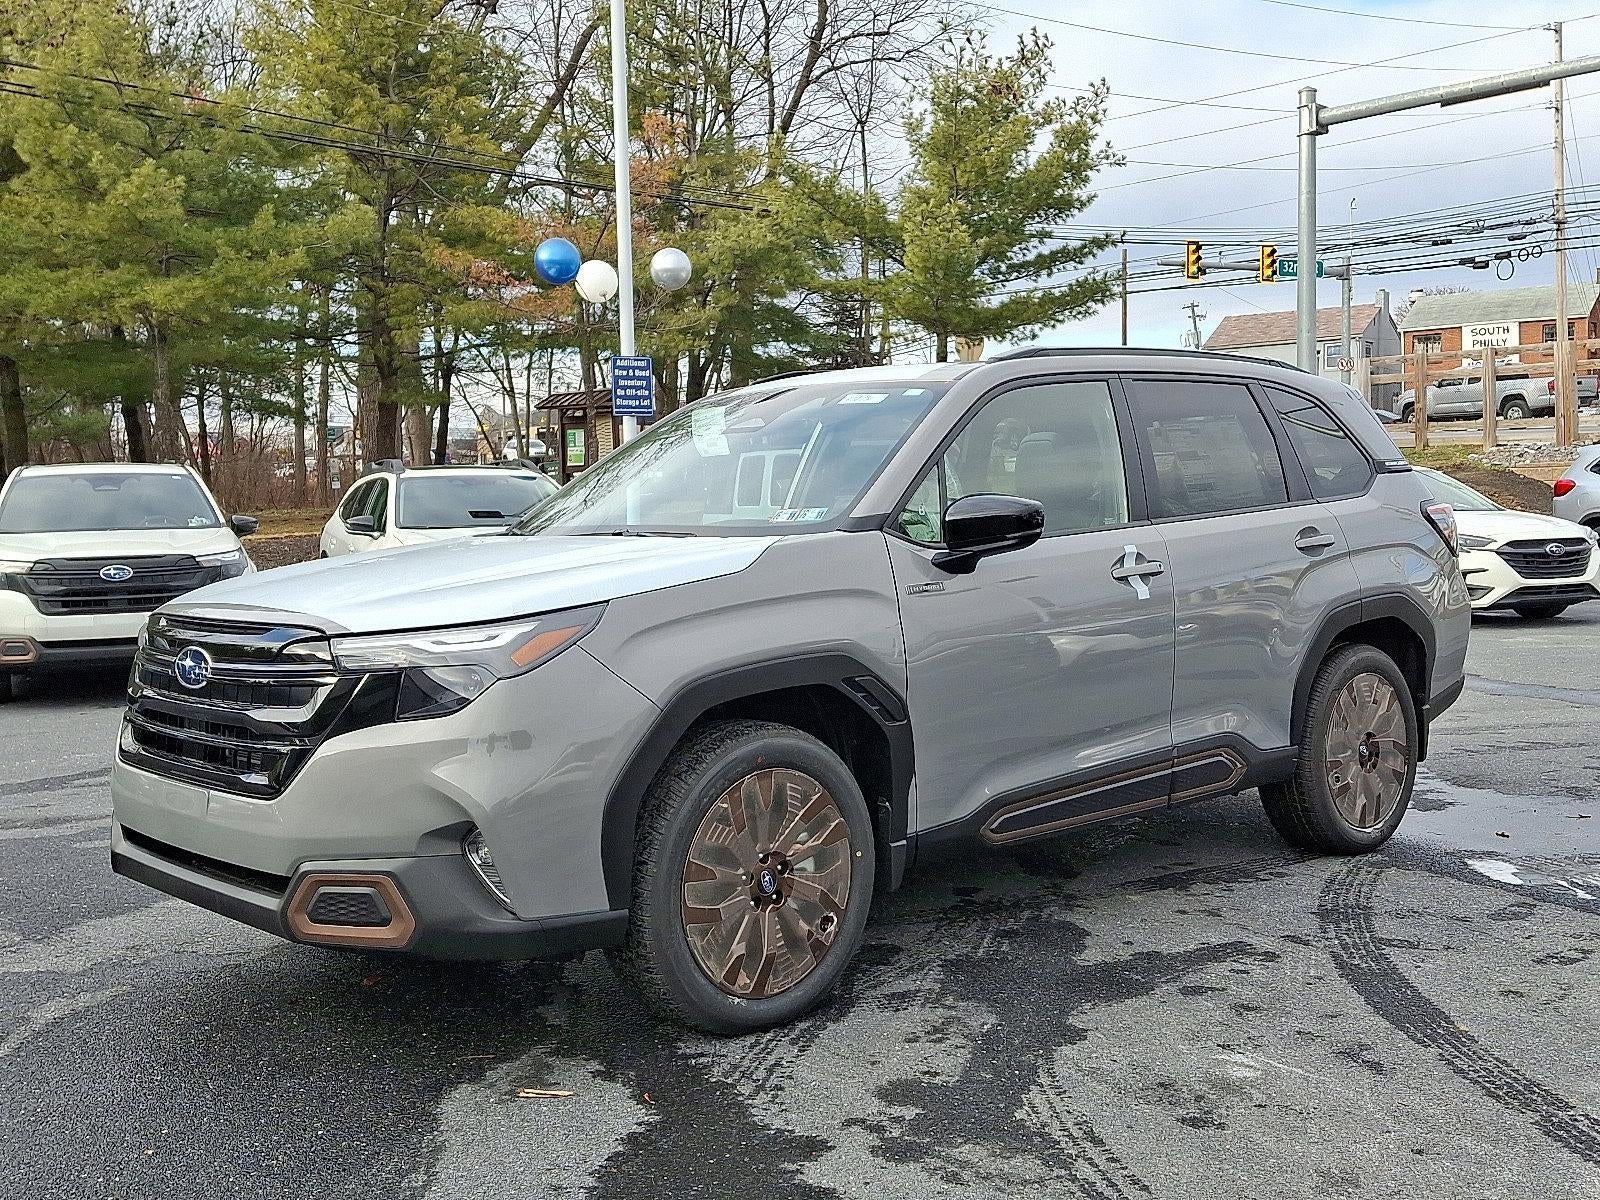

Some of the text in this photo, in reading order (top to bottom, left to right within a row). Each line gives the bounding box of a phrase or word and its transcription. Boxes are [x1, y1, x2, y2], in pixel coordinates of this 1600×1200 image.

[1283, 261, 1298, 273] 32n
[1471, 326, 1510, 337] SOUTH
[1472, 338, 1508, 348] PHILLY
[616, 359, 647, 367] Additional
[618, 379, 647, 388] Inventory
[616, 388, 624, 396] On
[616, 398, 651, 407] Storage Lot
